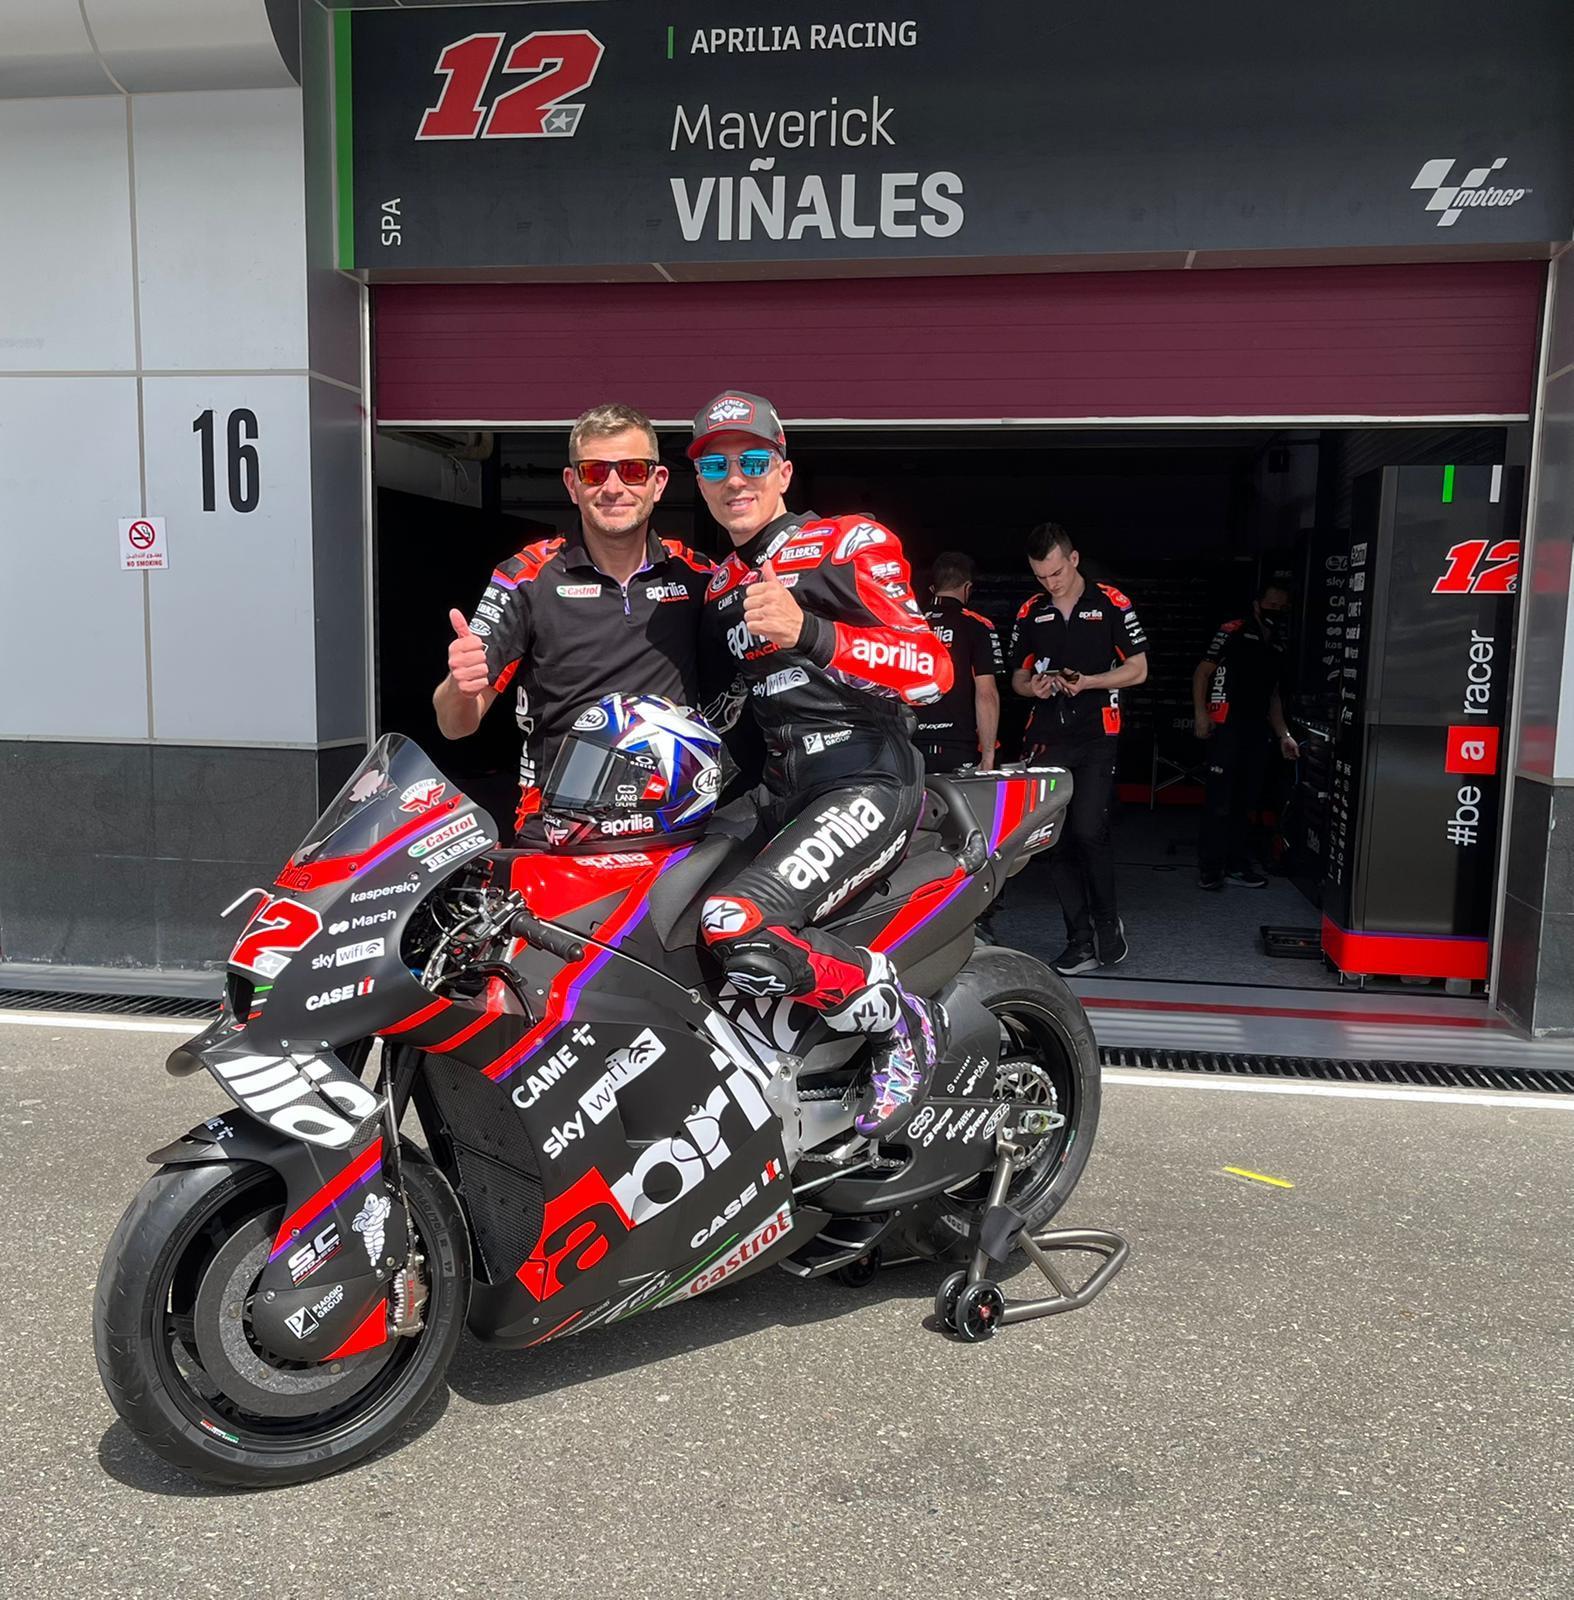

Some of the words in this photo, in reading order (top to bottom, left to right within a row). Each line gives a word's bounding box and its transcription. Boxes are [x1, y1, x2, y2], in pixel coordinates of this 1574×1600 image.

[690, 25, 800, 54] APRILIA
[809, 20, 918, 51] RACING
[414, 29, 605, 140] 12
[670, 96, 896, 151] Maverick
[380, 198, 402, 246] SPA
[669, 157, 965, 242] VIÑALES
[193, 408, 260, 513] 16
[1431, 539, 1520, 594] 12
[567, 586, 599, 597] Castrol
[645, 582, 688, 602] aprilia
[852, 637, 935, 676] aprilia
[1463, 629, 1494, 714] racer
[1460, 740, 1485, 761] a
[425, 816, 474, 848] Castrol
[600, 813, 654, 836] aprilia
[1446, 785, 1482, 847] #be
[778, 796, 887, 890] aprilia
[350, 880, 421, 903] kaspersky
[352, 909, 397, 929] Marsh
[311, 952, 336, 970] sky
[339, 942, 364, 962] wifi
[305, 984, 355, 1011] CASE
[511, 1044, 579, 1109] CAME
[542, 1110, 587, 1160] sky
[588, 1057, 628, 1112] wifi
[690, 1182, 759, 1249] CASE
[287, 1222, 341, 1277] SC
[690, 1211, 791, 1296] Castrol
[311, 1284, 343, 1314] PIAGGIO
[317, 1292, 344, 1318] GROUP
